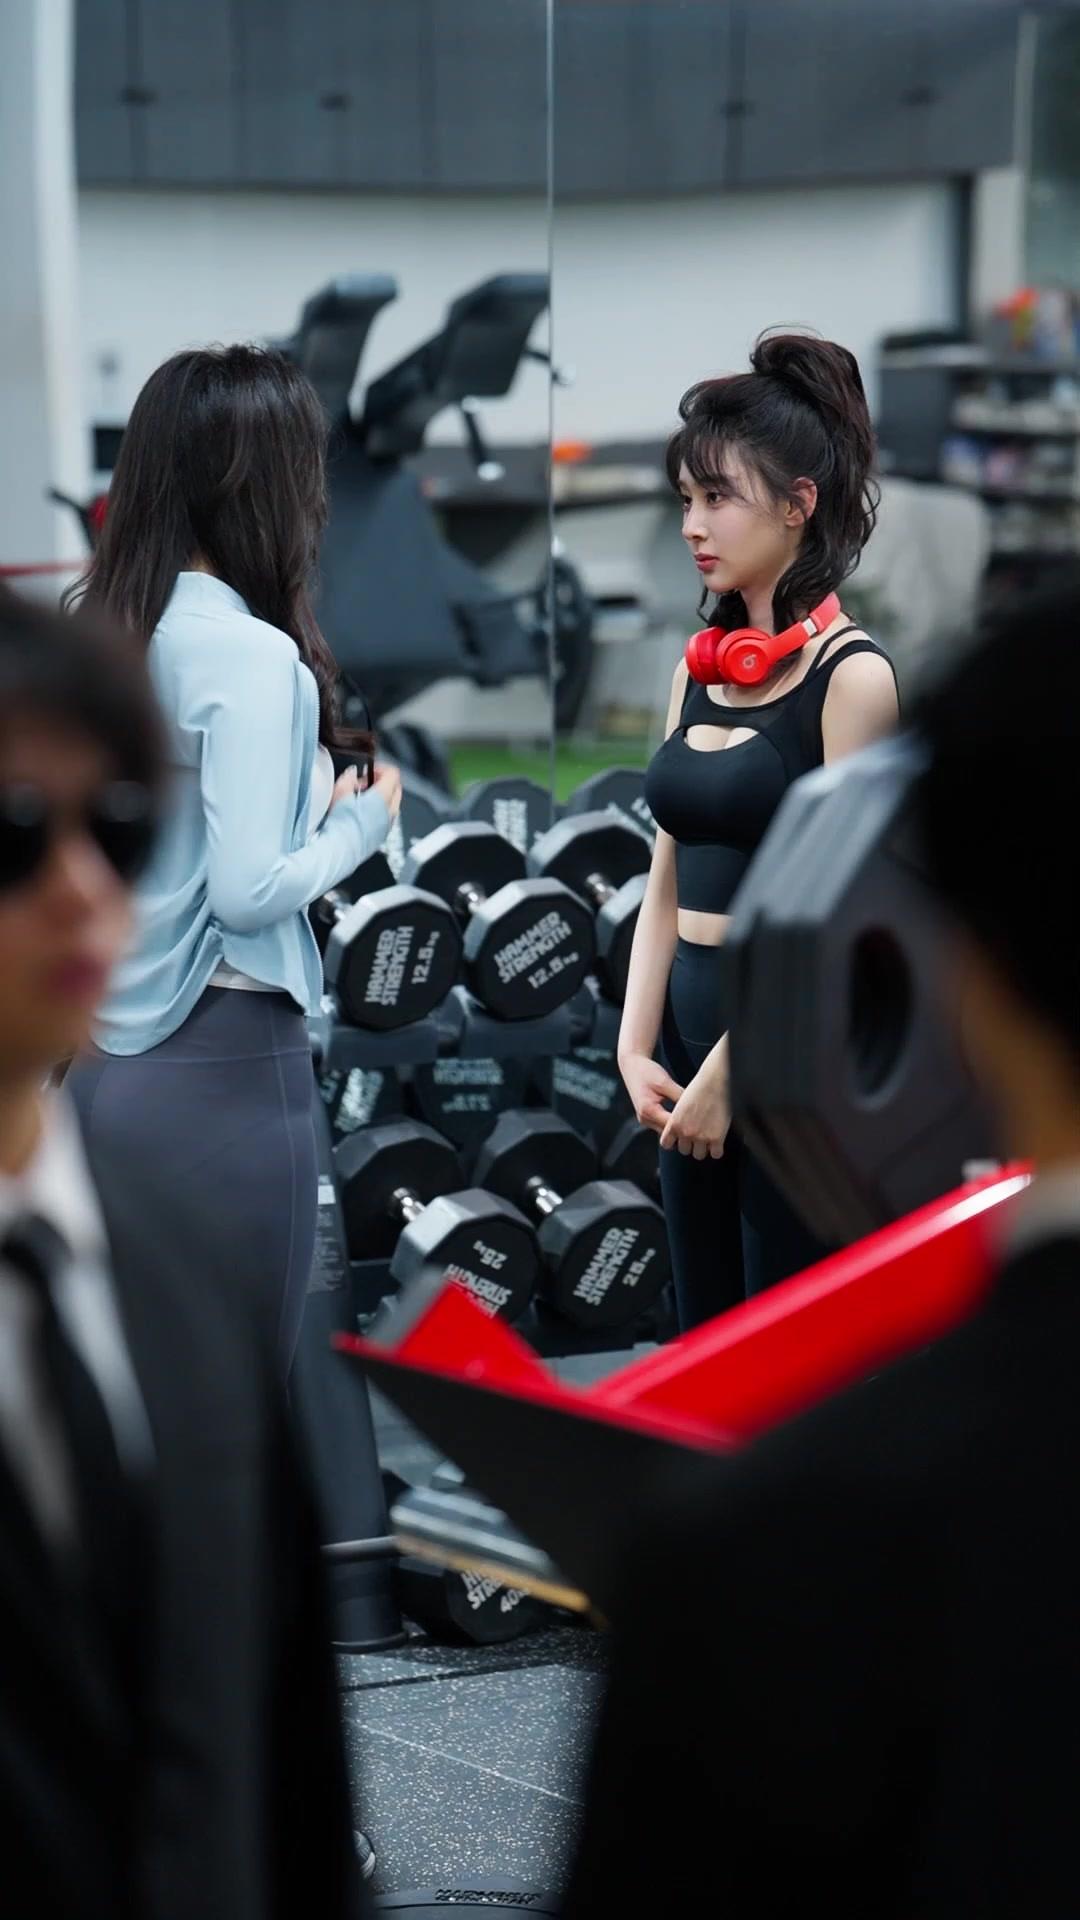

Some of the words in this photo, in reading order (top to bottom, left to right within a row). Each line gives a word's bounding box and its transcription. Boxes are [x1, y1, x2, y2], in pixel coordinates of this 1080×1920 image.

[364, 929, 396, 1002] HAMMER
[381, 925, 414, 1006] STRENGTH
[494, 911, 560, 974] HAMMER
[498, 921, 572, 984] STRENGTH
[573, 1227, 623, 1298] HAMMER
[585, 1228, 639, 1306] STRENGTH
